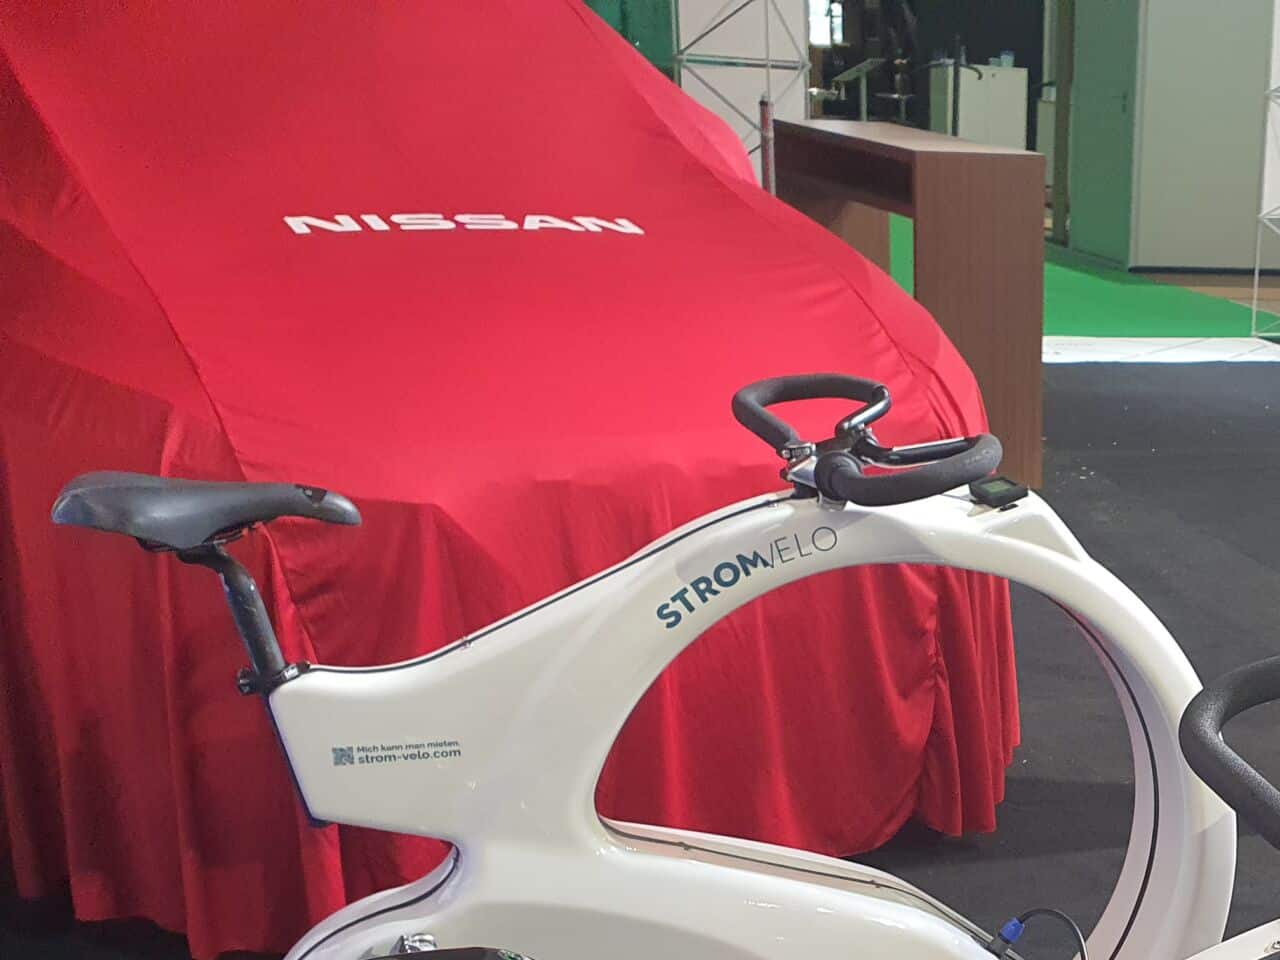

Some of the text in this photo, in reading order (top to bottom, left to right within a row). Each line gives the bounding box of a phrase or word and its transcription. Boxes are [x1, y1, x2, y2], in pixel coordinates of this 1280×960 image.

[284, 213, 645, 235] NISSAN
[381, 742, 403, 753] kann
[405, 740, 425, 751] man
[358, 748, 462, 764] strom-velo.com
